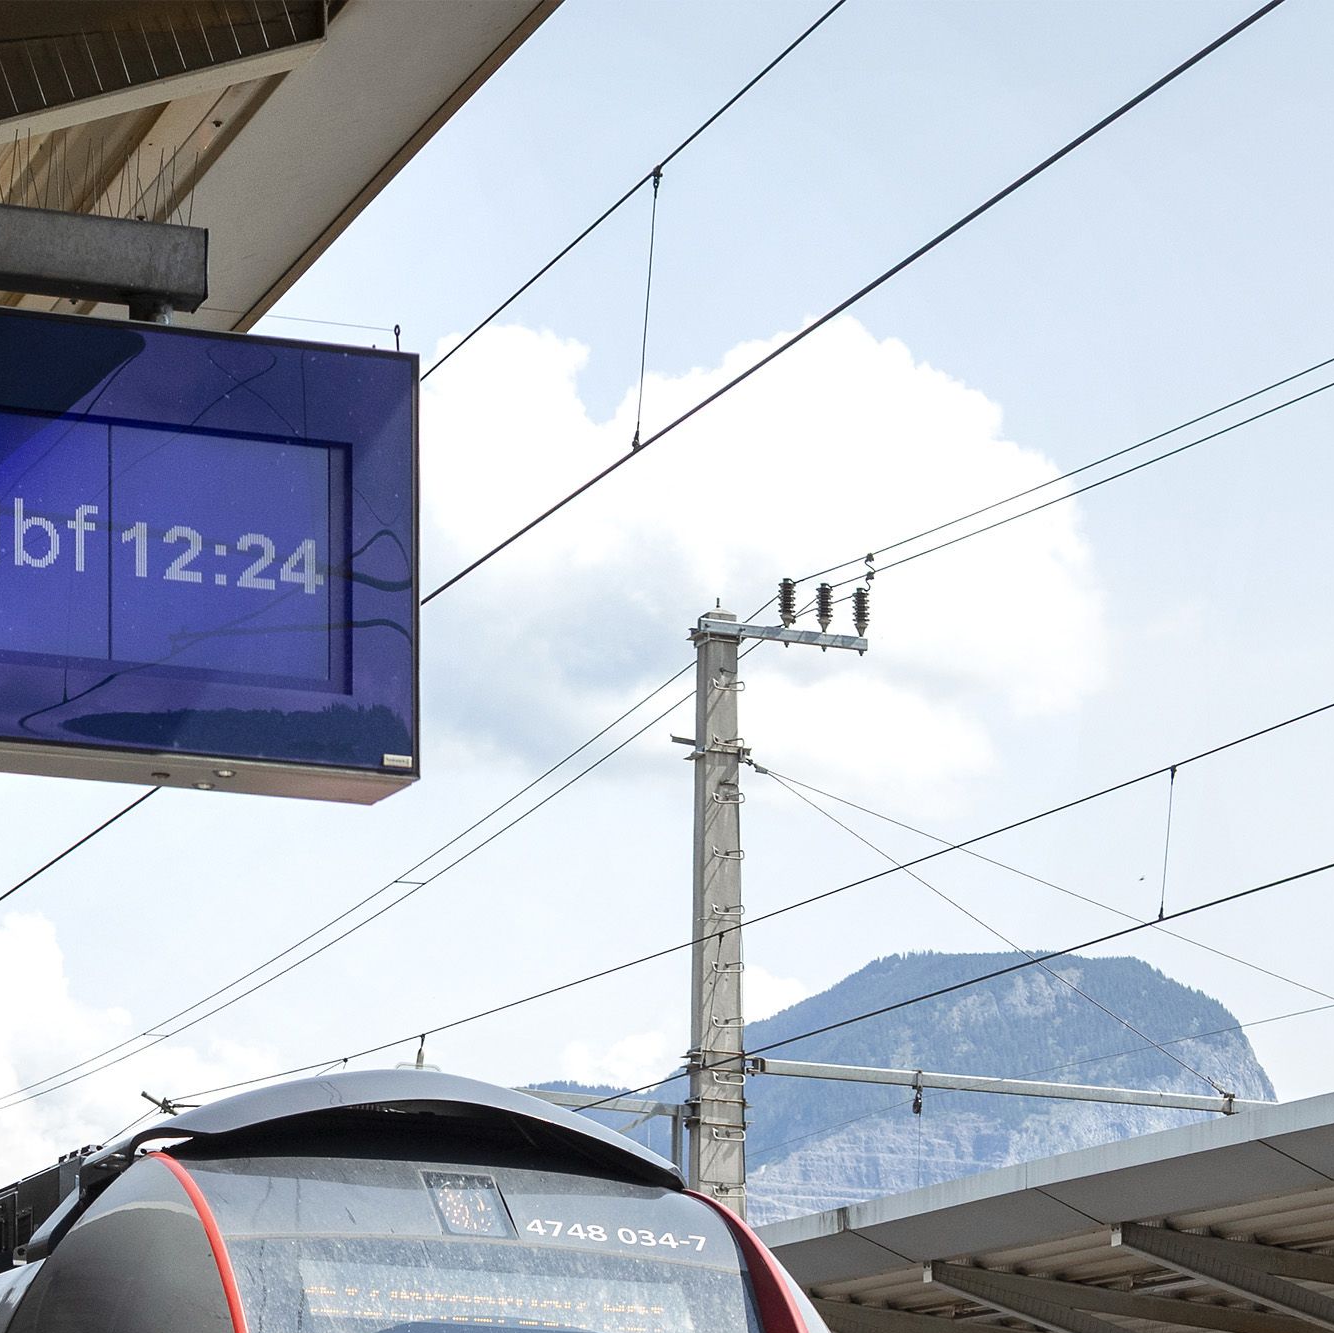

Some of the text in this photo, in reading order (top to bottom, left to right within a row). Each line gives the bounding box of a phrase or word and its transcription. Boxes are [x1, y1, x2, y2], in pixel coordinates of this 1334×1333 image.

[121, 521, 323, 595] 12:24
[527, 1219, 707, 1252] 4748 034-7
